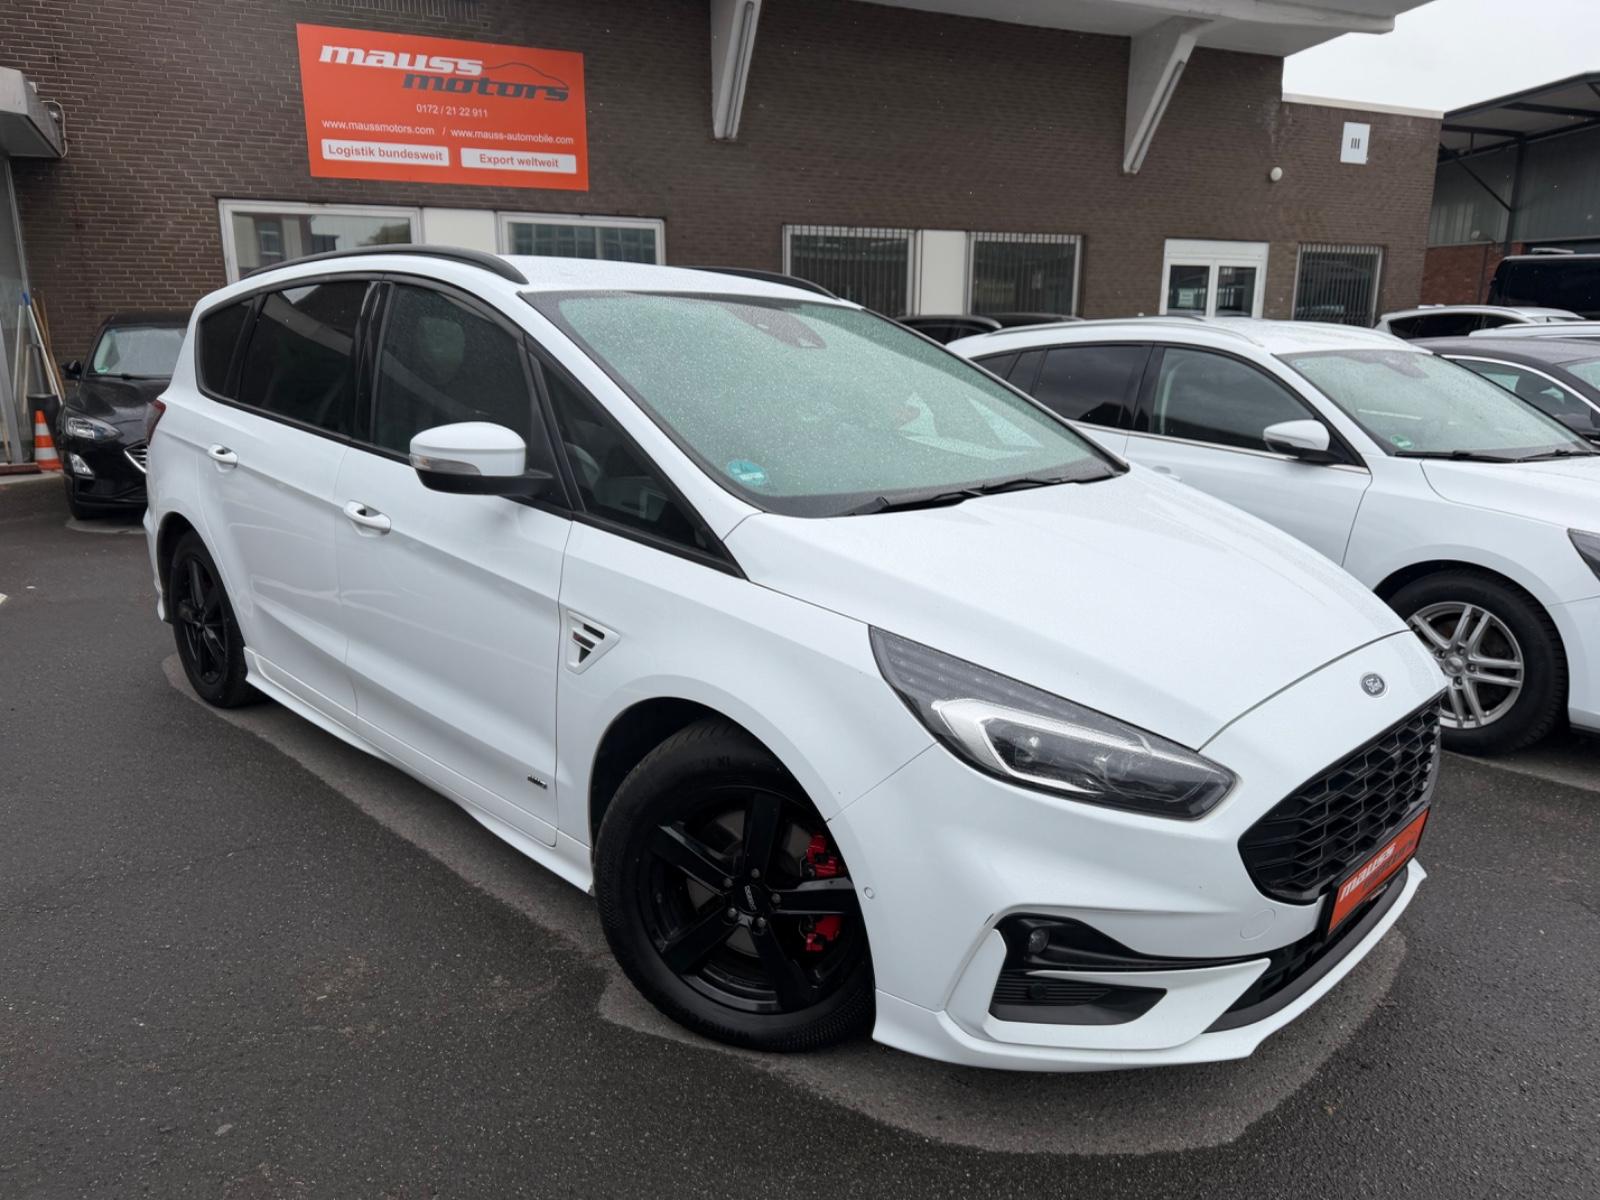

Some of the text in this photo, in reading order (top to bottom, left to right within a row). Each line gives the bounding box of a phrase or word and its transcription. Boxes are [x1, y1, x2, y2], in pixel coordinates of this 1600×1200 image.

[319, 45, 484, 76] mauss
[402, 73, 569, 101] motors
[416, 103, 439, 115] 0172
[446, 105, 457, 116] 21
[459, 106, 471, 117] 22
[472, 107, 488, 118] 911
[321, 119, 435, 136] www.maussmotors.com
[450, 128, 574, 145] www.mauss-automobile.com
[328, 144, 443, 161] Logistik bundesweit
[479, 153, 515, 166] Export
